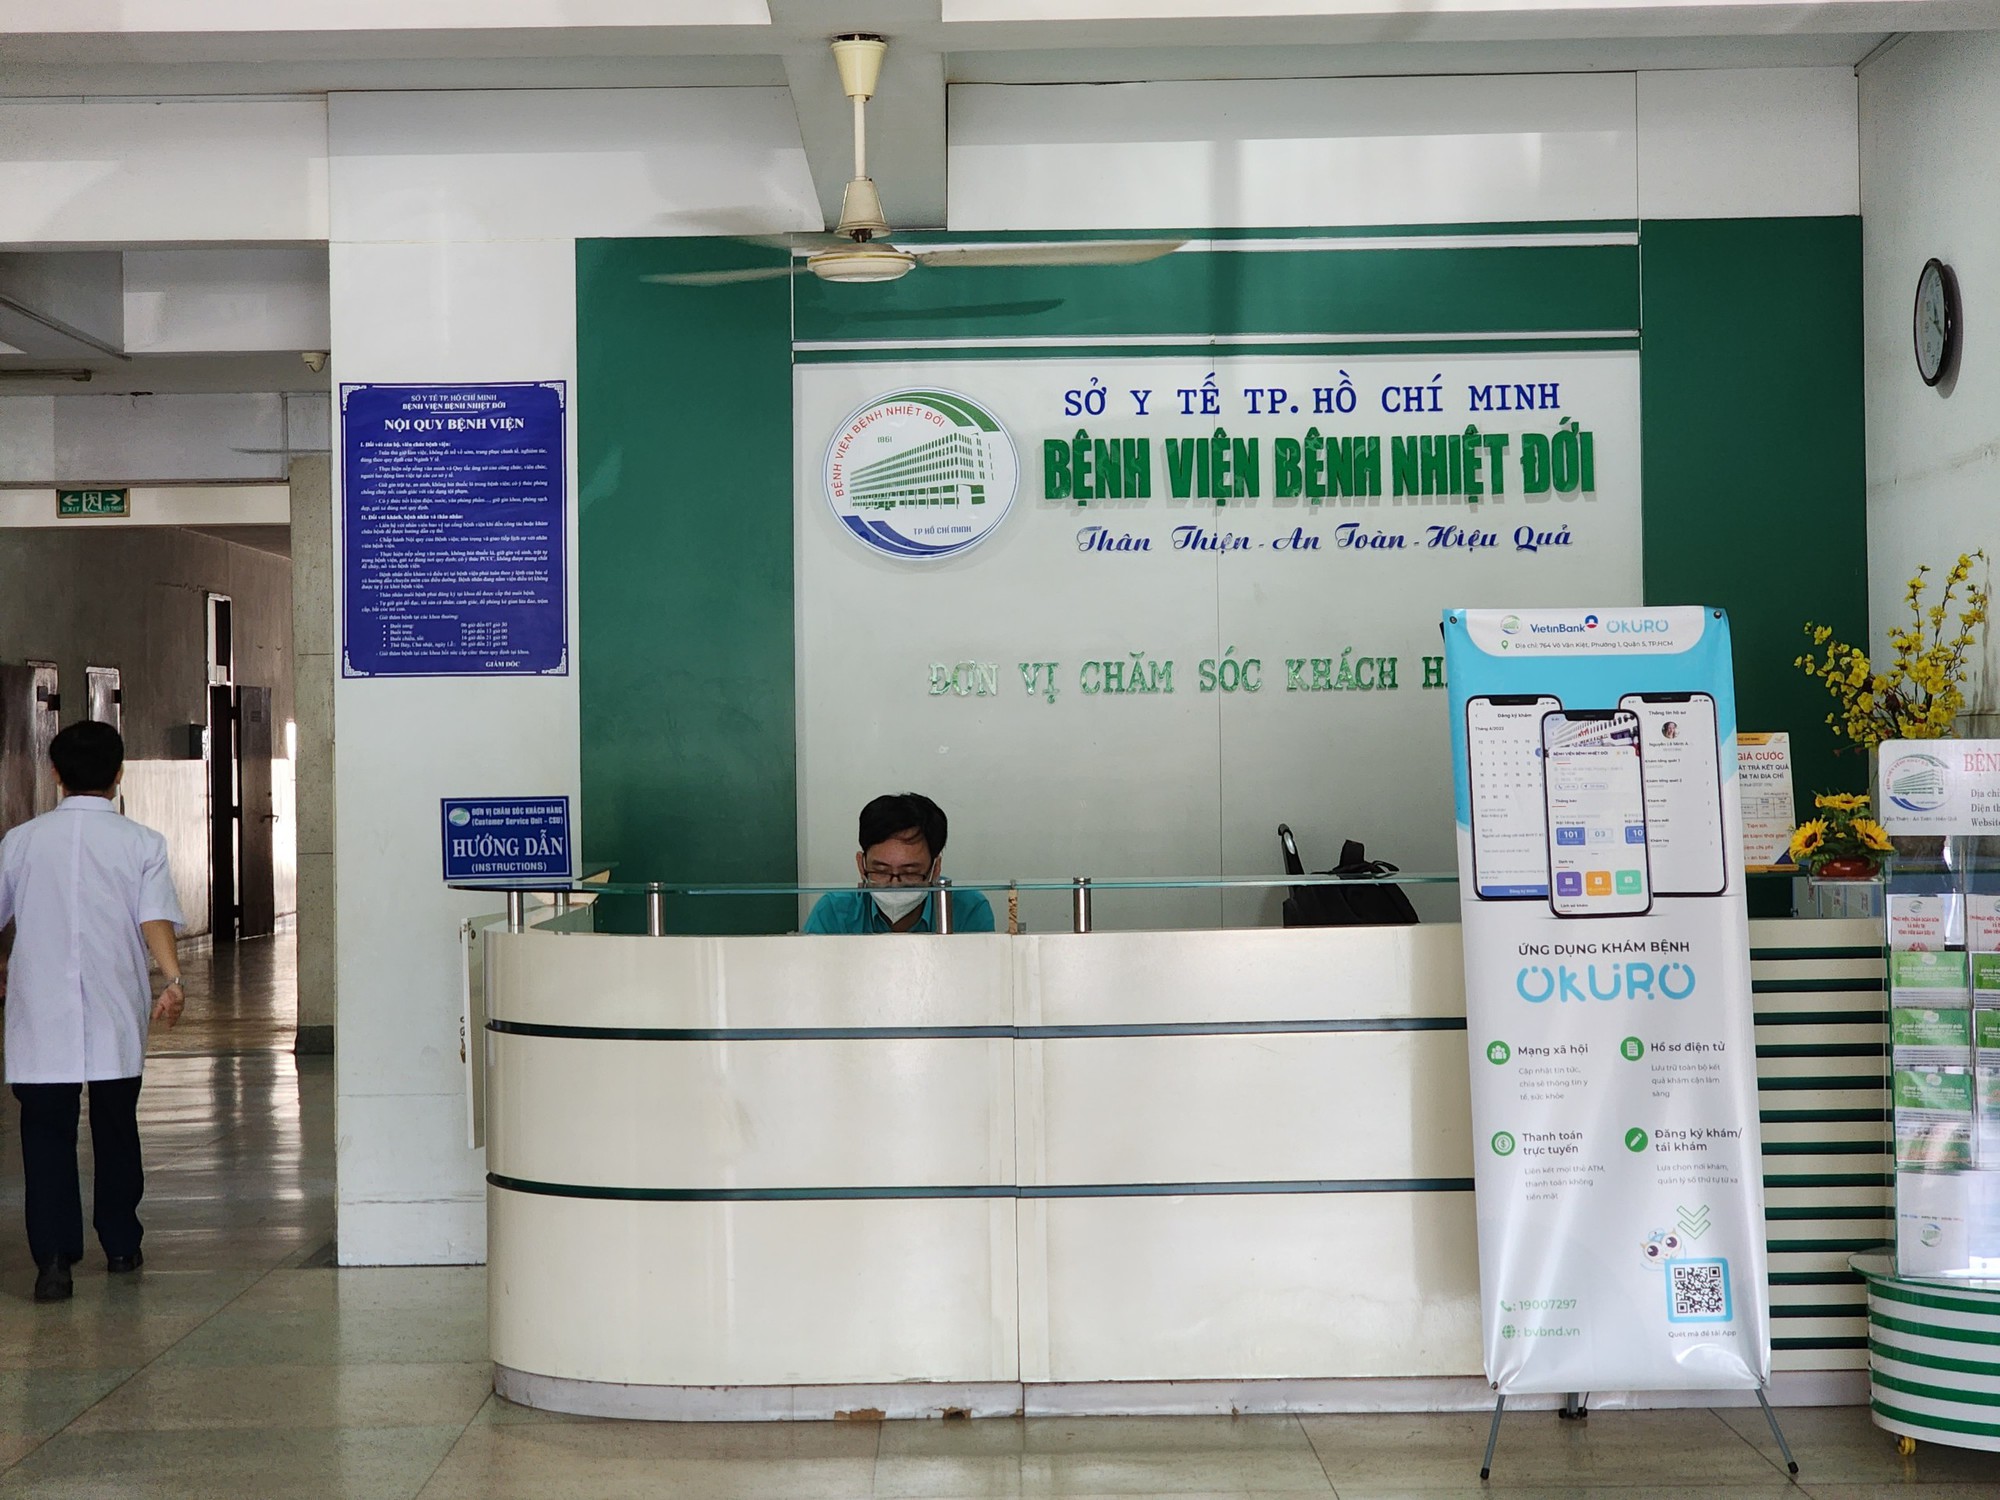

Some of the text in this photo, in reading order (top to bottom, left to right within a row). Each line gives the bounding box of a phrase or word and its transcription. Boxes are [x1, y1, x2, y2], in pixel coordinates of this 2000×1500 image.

[1065, 369, 1560, 416] SỞ Y TẾ TP. HỒ CHÍ MINH
[402, 403, 423, 411] BỆNH
[467, 402, 491, 410] NHIỆT
[492, 401, 506, 409] ĐỚI
[385, 417, 524, 432] NỘI QUY BỆNH VIỆN
[831, 404, 945, 497] BỆNH VIỆN BỆNH NHIỆT ĐỚI
[1044, 417, 1594, 506] BỆNH VIỆN BỆNH NHIỆT ĐỚI
[1077, 523, 1573, 554] Thân Thiện An Toàn Hiệu Quả
[1530, 624, 1585, 634] VietinBank
[929, 660, 999, 696] ĐƠN
[1018, 662, 1060, 704] VỊ
[1080, 651, 1174, 693] CHĂM
[1199, 645, 1261, 692] SÓC
[1286, 646, 1398, 691] KHÁCH
[1755, 751, 1784, 760] CƯỚC
[1963, 748, 2000, 776] BỆN
[472, 805, 562, 817] ĐƠN VỊ CHĂM SÓC KHÁCH HÀNG
[472, 818, 503, 826] (Customer
[506, 817, 529, 825] Service
[549, 816, 563, 824] CSU)
[453, 829, 563, 857] HƯỚNG DẪN
[472, 862, 546, 873] (INSTRUCTIONS)
[1519, 939, 1689, 957] ỨNG DỤNG KHÁM BỆNH
[1518, 1044, 1588, 1057] Mạng xã hội
[1685, 1042, 1709, 1053] điện
[1713, 1041, 1725, 1051] tử
[1522, 1131, 1583, 1141] Thanh toán
[1655, 1128, 1742, 1139] Đăng ký khám/
[1524, 1143, 1578, 1157] trực tuyến
[1656, 1141, 1707, 1151] tái khám
[1519, 1300, 1577, 1311] 19007297
[1524, 1327, 1580, 1337] bvbnd.vn
[1722, 1330, 1736, 1338] App
